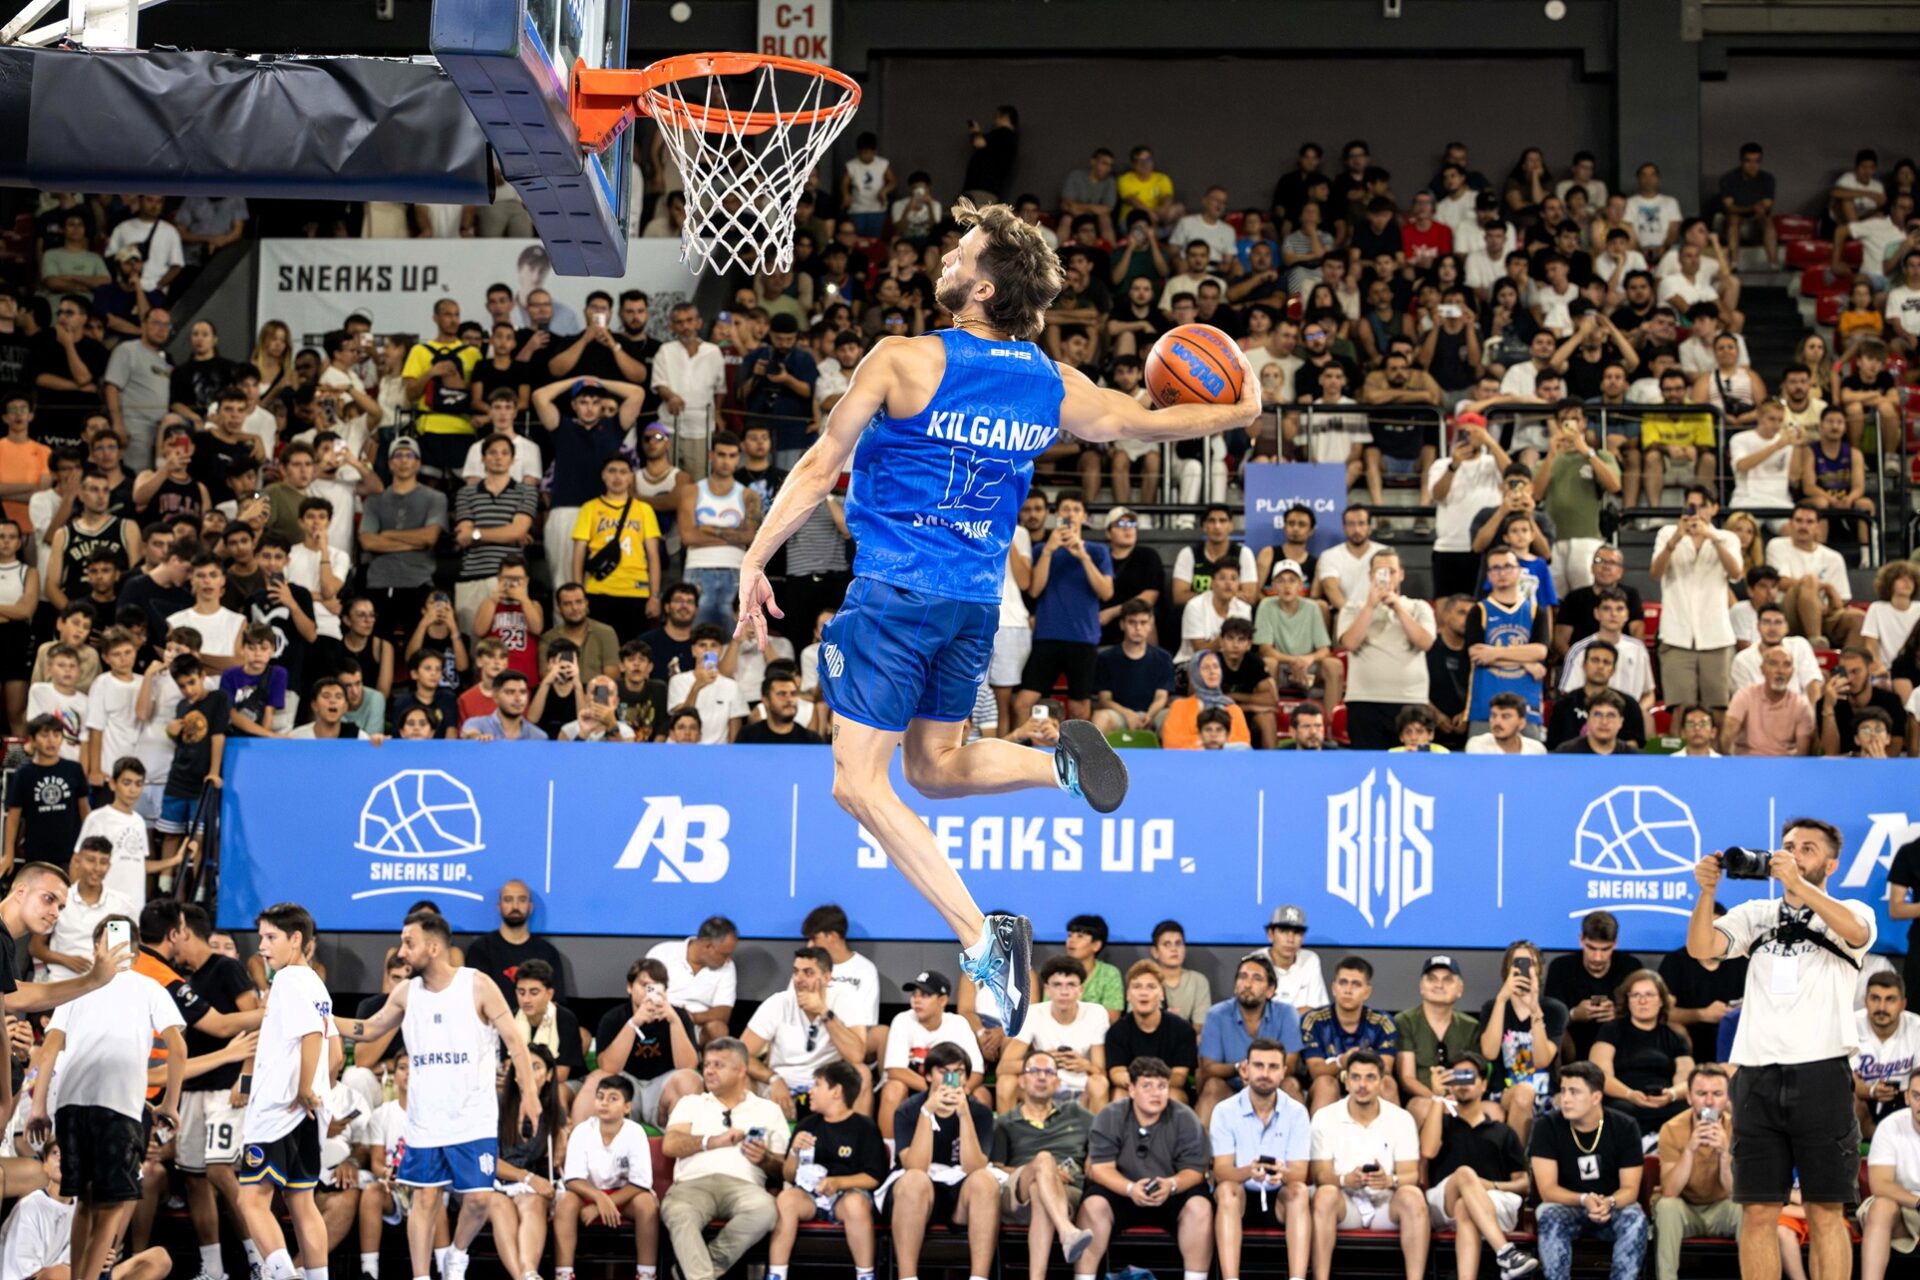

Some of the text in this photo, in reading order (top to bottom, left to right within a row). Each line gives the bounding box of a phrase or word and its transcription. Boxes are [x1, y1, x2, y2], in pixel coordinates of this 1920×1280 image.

[776, 4, 814, 29] C-1
[763, 34, 827, 59] BLOK
[278, 265, 392, 292] SNEAKS
[926, 410, 1059, 451] KILGANON
[1314, 499, 1335, 512] C4
[501, 629, 526, 650] 23
[857, 816, 1083, 871] SEAKS
[370, 862, 440, 881] SNEAKS
[1587, 880, 1659, 899] SNEAKS
[206, 1123, 233, 1149] 19
